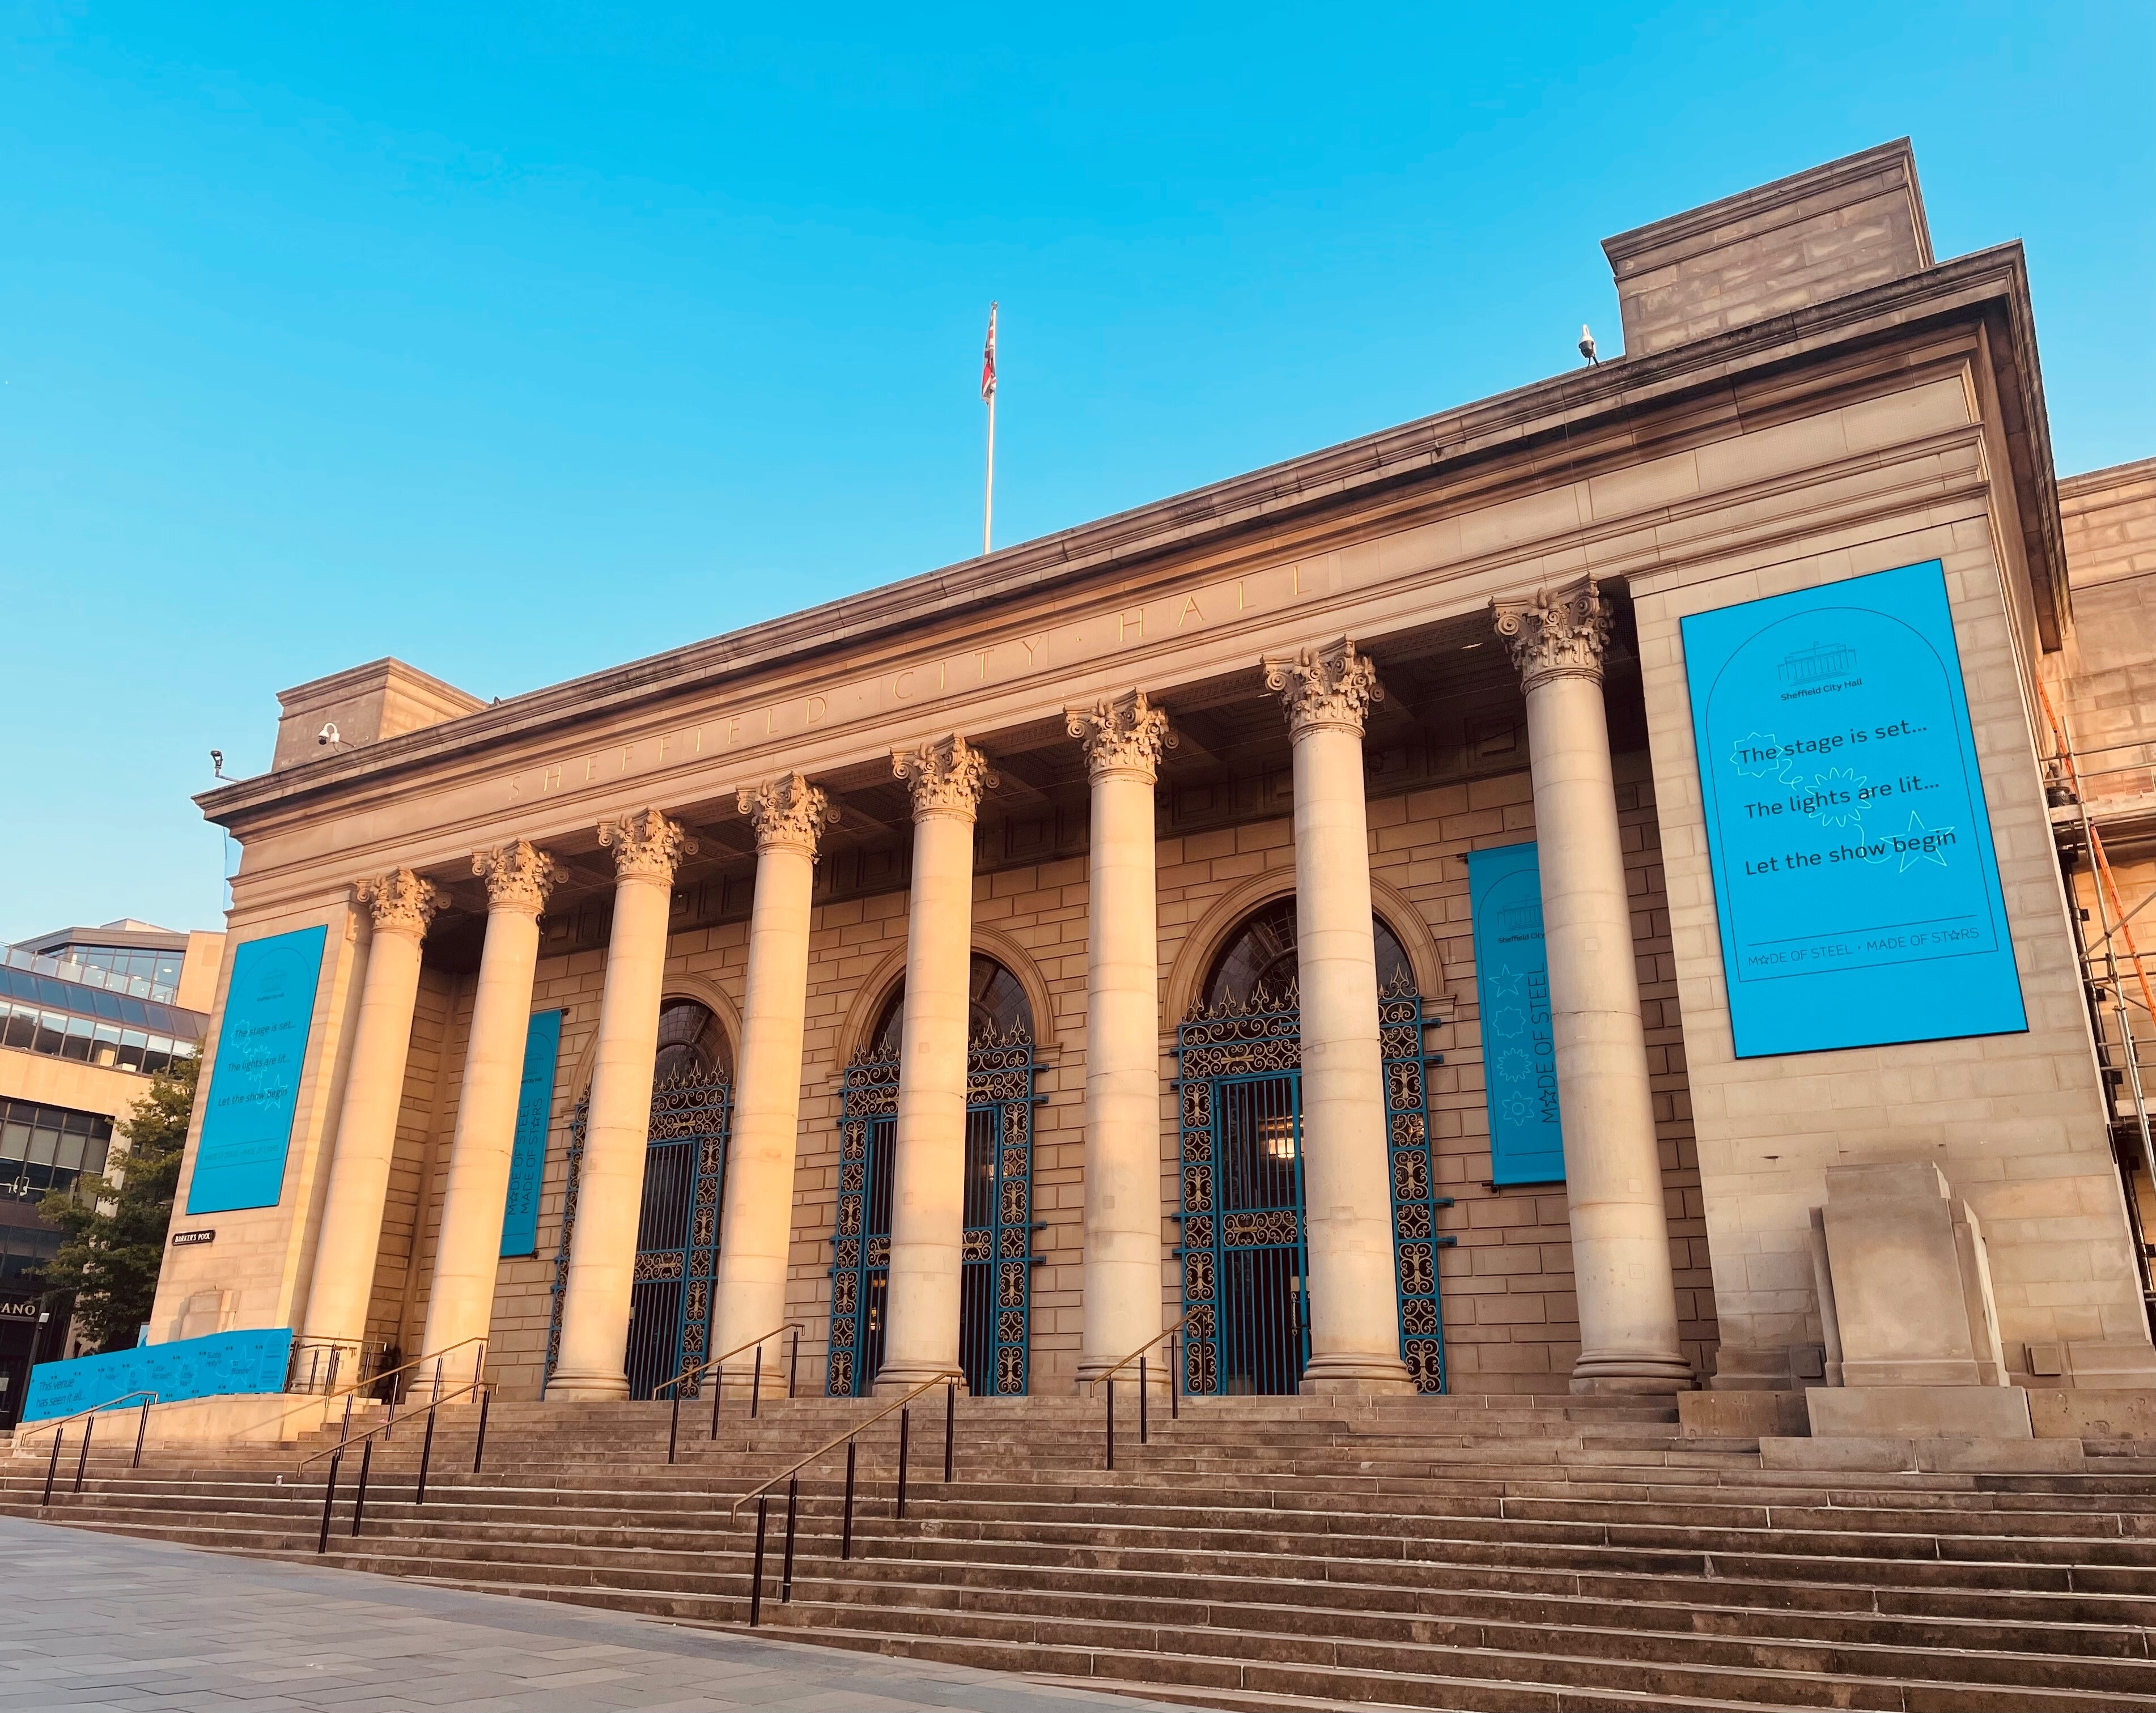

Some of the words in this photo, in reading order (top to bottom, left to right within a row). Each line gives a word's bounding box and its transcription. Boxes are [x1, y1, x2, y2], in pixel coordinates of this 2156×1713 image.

[509, 696, 826, 801] SHEFFIELD
[893, 636, 1042, 699] CITY
[1119, 566, 1313, 641] HALL
[1781, 687, 1821, 701] Sheffield
[1844, 678, 1862, 688] Hall
[1739, 746, 1777, 764] The
[1784, 735, 1843, 756] stage
[1850, 729, 1868, 743] is
[1875, 720, 1927, 739] set...
[1744, 801, 1782, 819] The
[1789, 790, 1851, 814] lights
[1858, 784, 1892, 800] are
[1899, 776, 1939, 793] lit...
[1746, 857, 1780, 875] Let
[1786, 852, 1822, 869] the
[1829, 844, 1886, 862] show
[1893, 830, 1956, 853] begin
[1498, 933, 1529, 943] Sheffield
[1790, 949, 1808, 962] OF
[1811, 944, 1853, 959] STEEL
[1867, 936, 1906, 951] MADE
[1910, 933, 1928, 946] OF
[1527, 962, 1550, 1025] STEEL
[235, 1029, 248, 1038] The
[249, 1025, 269, 1037] stage
[271, 1023, 277, 1031] is
[1533, 1030, 1552, 1056] OF
[228, 1062, 240, 1072] The
[242, 1059, 262, 1072] lights
[264, 1057, 277, 1066] are
[218, 1096, 230, 1106] Let
[232, 1094, 244, 1104] the
[246, 1091, 265, 1102] show
[267, 1088, 287, 1100] begin
[516, 1100, 530, 1144] STEEL
[513, 1149, 523, 1167] OF
[526, 1150, 536, 1167] OF
[521, 1171, 534, 1213] MADE
[175, 1234, 197, 1243] BARKER'S
[39, 1382, 52, 1391] This
[54, 1378, 74, 1389] venue
[36, 1398, 48, 1408] has
[49, 1396, 66, 1406] seen
[67, 1395, 73, 1404] it
